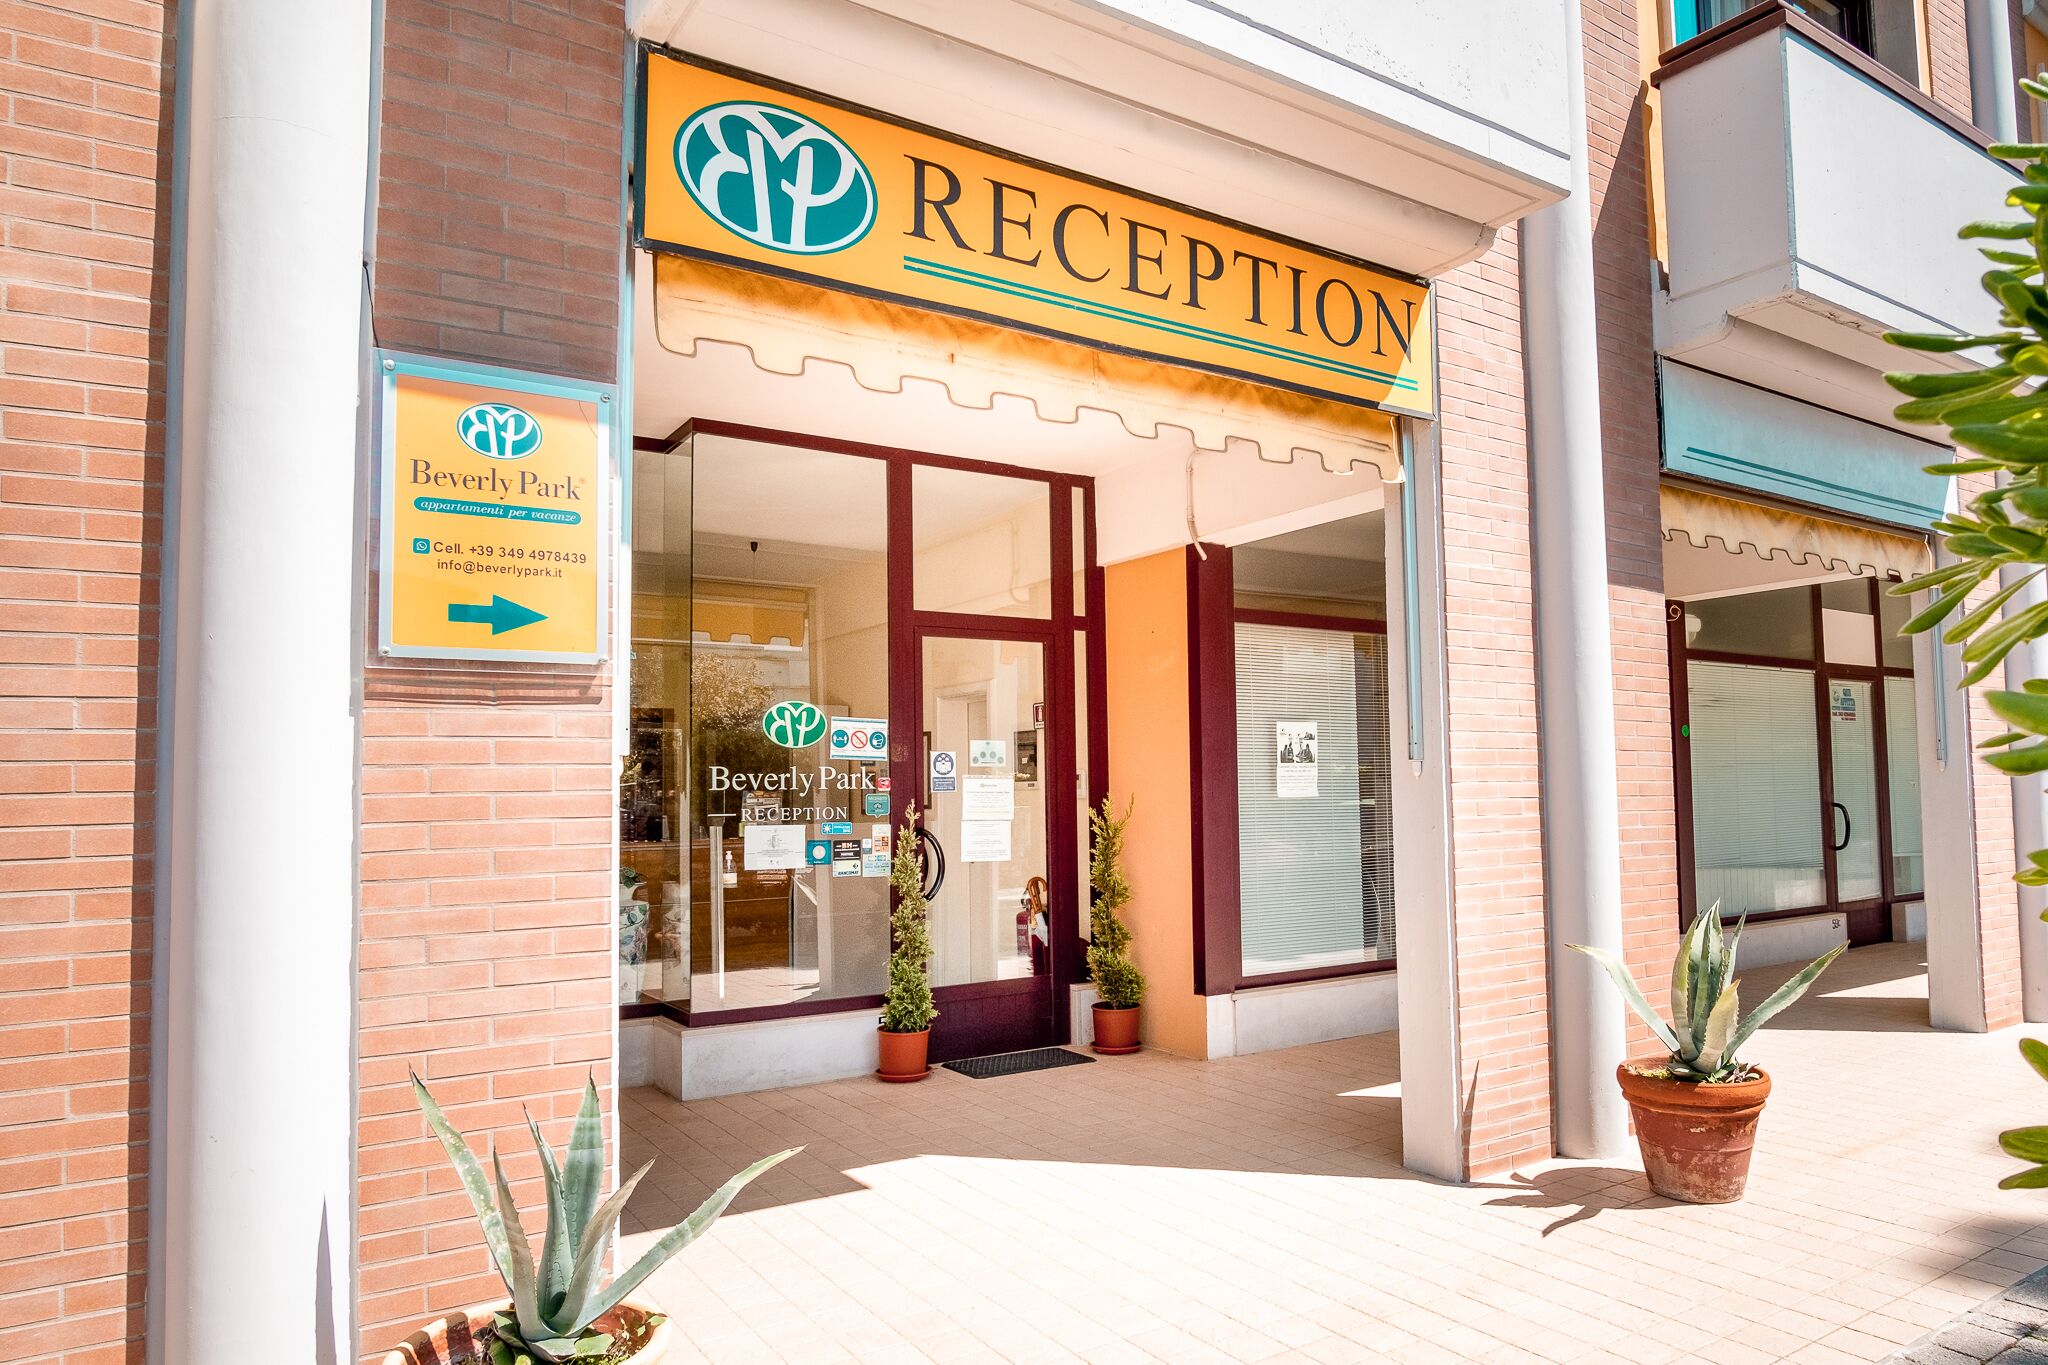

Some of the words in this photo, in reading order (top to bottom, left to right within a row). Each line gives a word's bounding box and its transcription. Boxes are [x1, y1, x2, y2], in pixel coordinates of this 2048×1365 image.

[902, 153, 1418, 363] RECEPTION
[409, 458, 513, 500] Beverly
[420, 499, 505, 516] appartamenti
[507, 507, 528, 519] per
[531, 511, 577, 522] vacanze
[433, 541, 464, 555] Cell.
[469, 545, 494, 556] +39
[498, 546, 525, 559] 349
[529, 549, 587, 564] 4978439
[437, 559, 562, 578] info@beverlypark.it
[708, 765, 815, 797] Beverly
[818, 766, 878, 791] Park
[741, 806, 848, 822] RECEPTION
